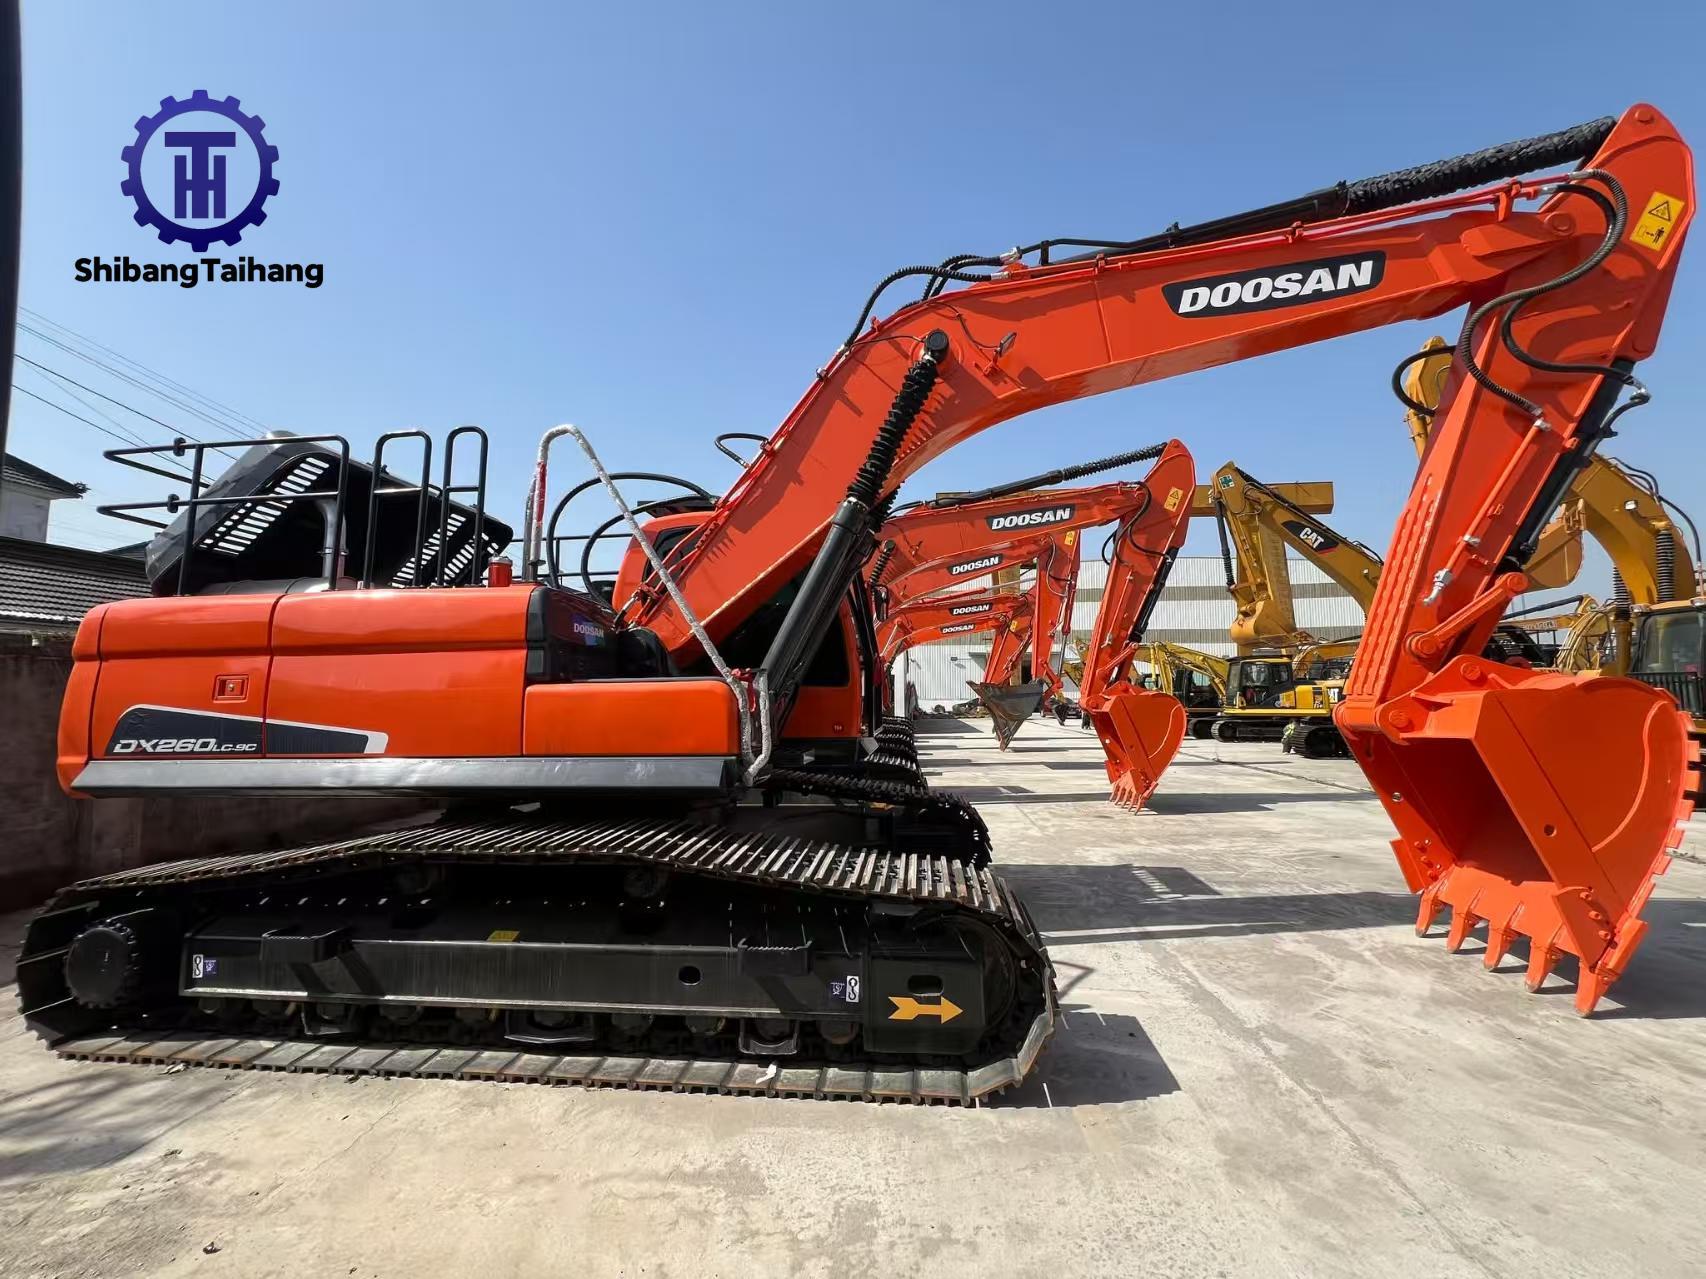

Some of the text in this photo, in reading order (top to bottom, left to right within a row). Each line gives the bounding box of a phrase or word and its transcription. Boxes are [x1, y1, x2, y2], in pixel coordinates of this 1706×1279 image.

[1178, 260, 1373, 314] DOOSAN
[991, 508, 1070, 530] DOOSAN
[1300, 527, 1325, 549] CAT
[952, 556, 999, 575] DOOSAN
[953, 604, 989, 615] DOOSAN
[573, 623, 604, 638] DOOSAN
[942, 624, 974, 634] DOOSAN
